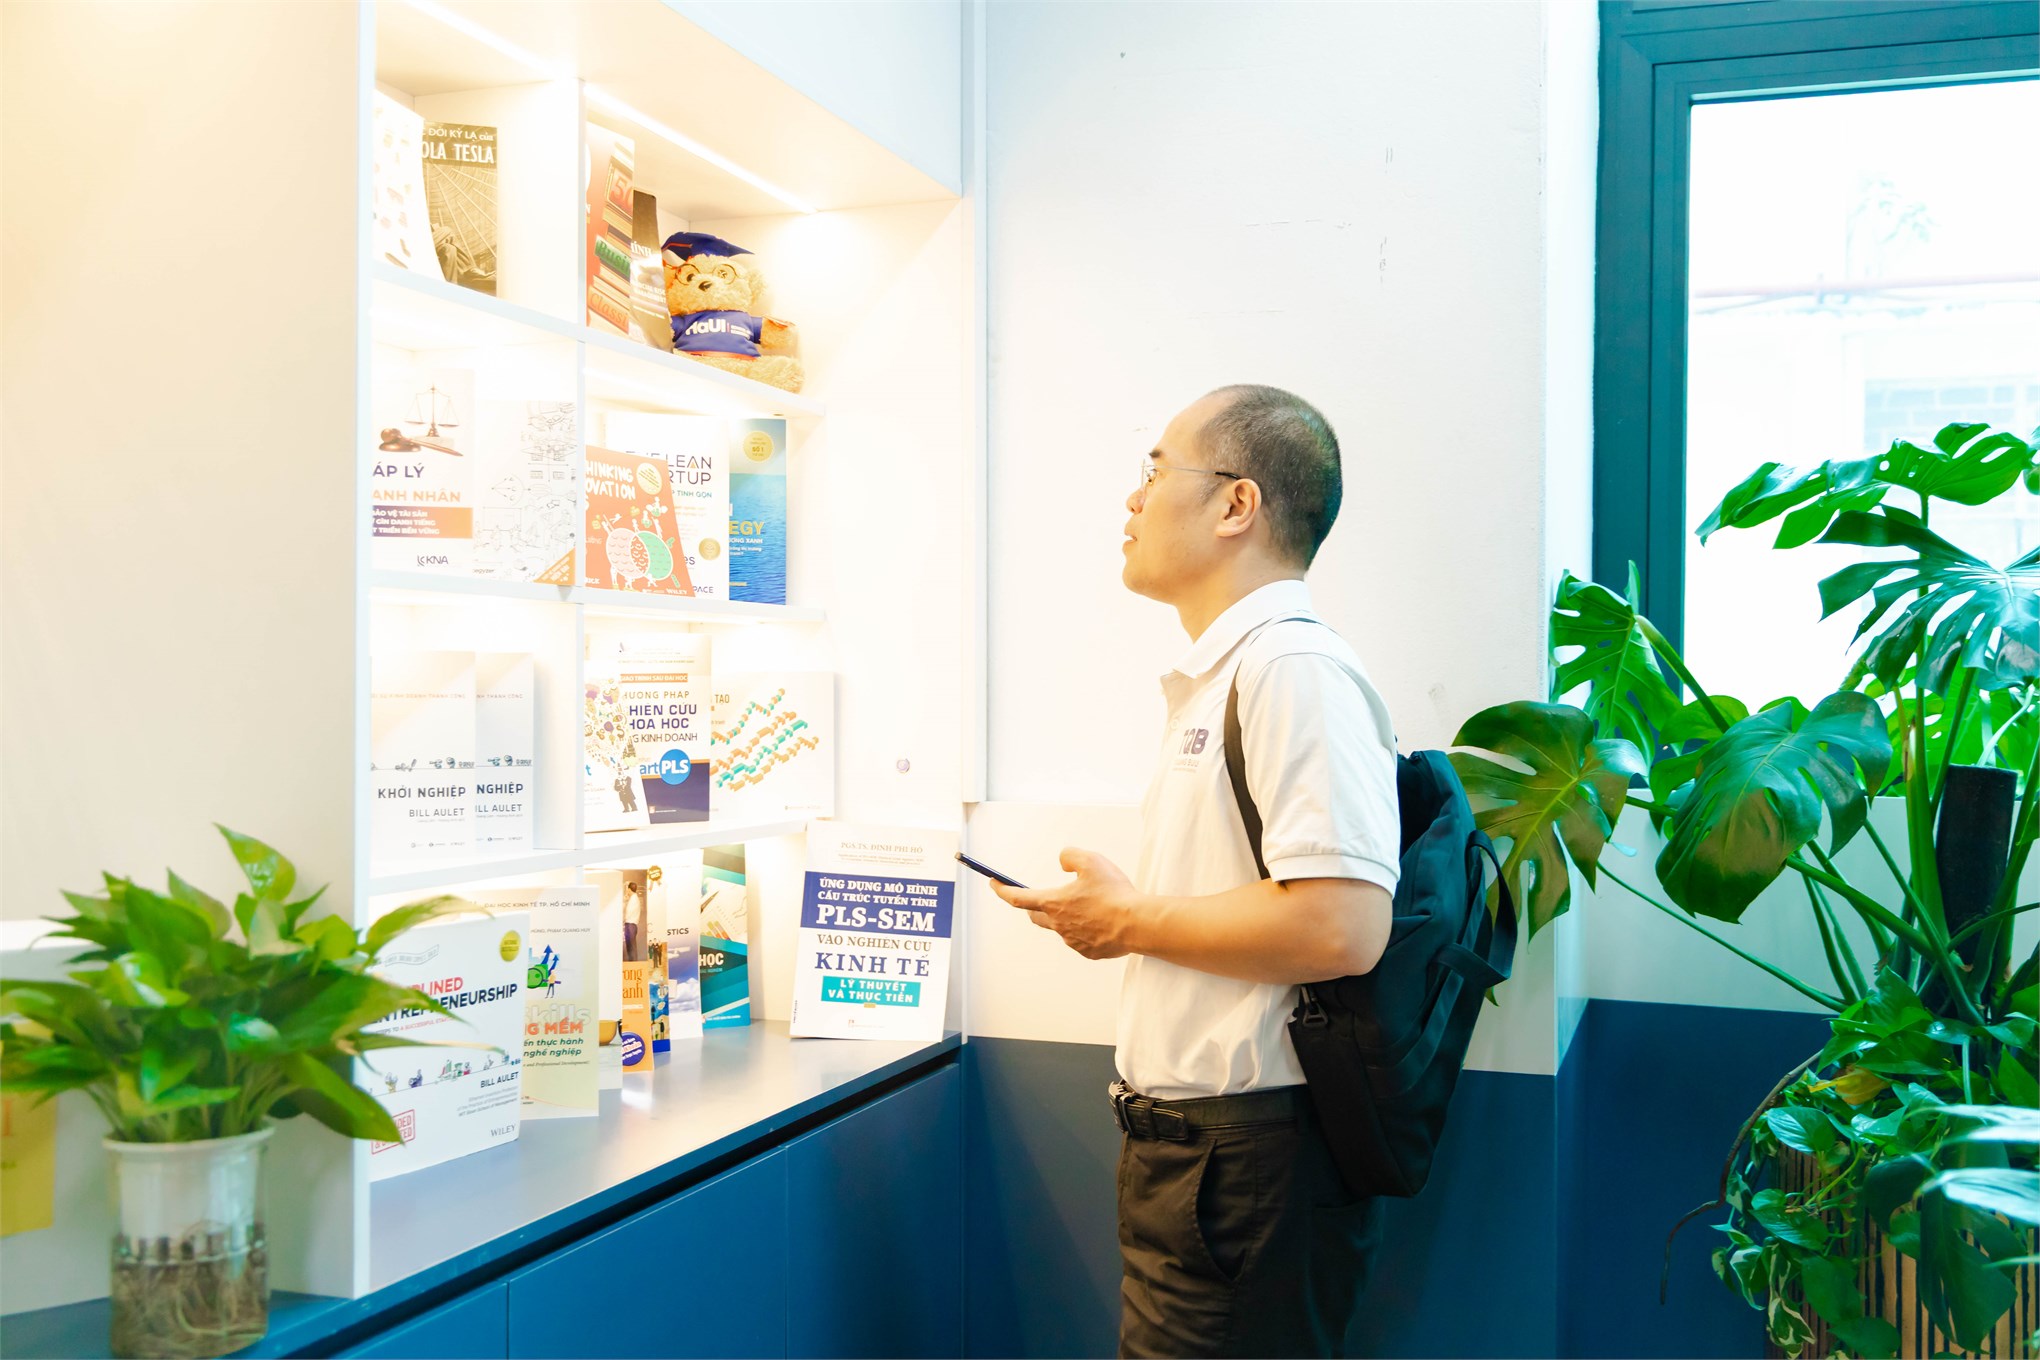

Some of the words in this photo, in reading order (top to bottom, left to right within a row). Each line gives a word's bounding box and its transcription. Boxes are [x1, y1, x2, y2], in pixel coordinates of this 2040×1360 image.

[453, 143, 495, 164] TESLA
[372, 461, 398, 478] ÁP
[404, 462, 425, 478] LÝ
[372, 489, 407, 501] ANH
[413, 488, 461, 502] NHÂN
[641, 733, 663, 742] KINH
[664, 732, 698, 742] DOANH
[417, 785, 467, 800] NGHIỆP
[476, 781, 524, 796] NGHIỆP
[409, 809, 430, 817] BILL
[433, 807, 465, 817] AULET
[492, 803, 523, 812] AULET
[819, 877, 845, 890] ỨNG
[847, 880, 882, 892] DỤNG
[883, 881, 904, 893] MÔ
[906, 883, 938, 896] HÌNH
[842, 892, 871, 903] TRÚC
[872, 894, 909, 906] TUYẾN
[910, 896, 938, 908] TÍNH
[815, 903, 936, 933] PLS-SEM
[667, 927, 689, 936] STICS
[699, 953, 724, 968] HỌC
[814, 951, 888, 974] KINH
[896, 954, 930, 977] TẾ
[828, 988, 845, 999] VÀ
[848, 990, 882, 1002] THỰC
[536, 1038, 557, 1048] thực
[559, 1037, 584, 1045] hành
[549, 1047, 582, 1057] nghiệp
[480, 1078, 496, 1089] BILL
[496, 1071, 519, 1084] AULET
[490, 1124, 516, 1137] WILEY
